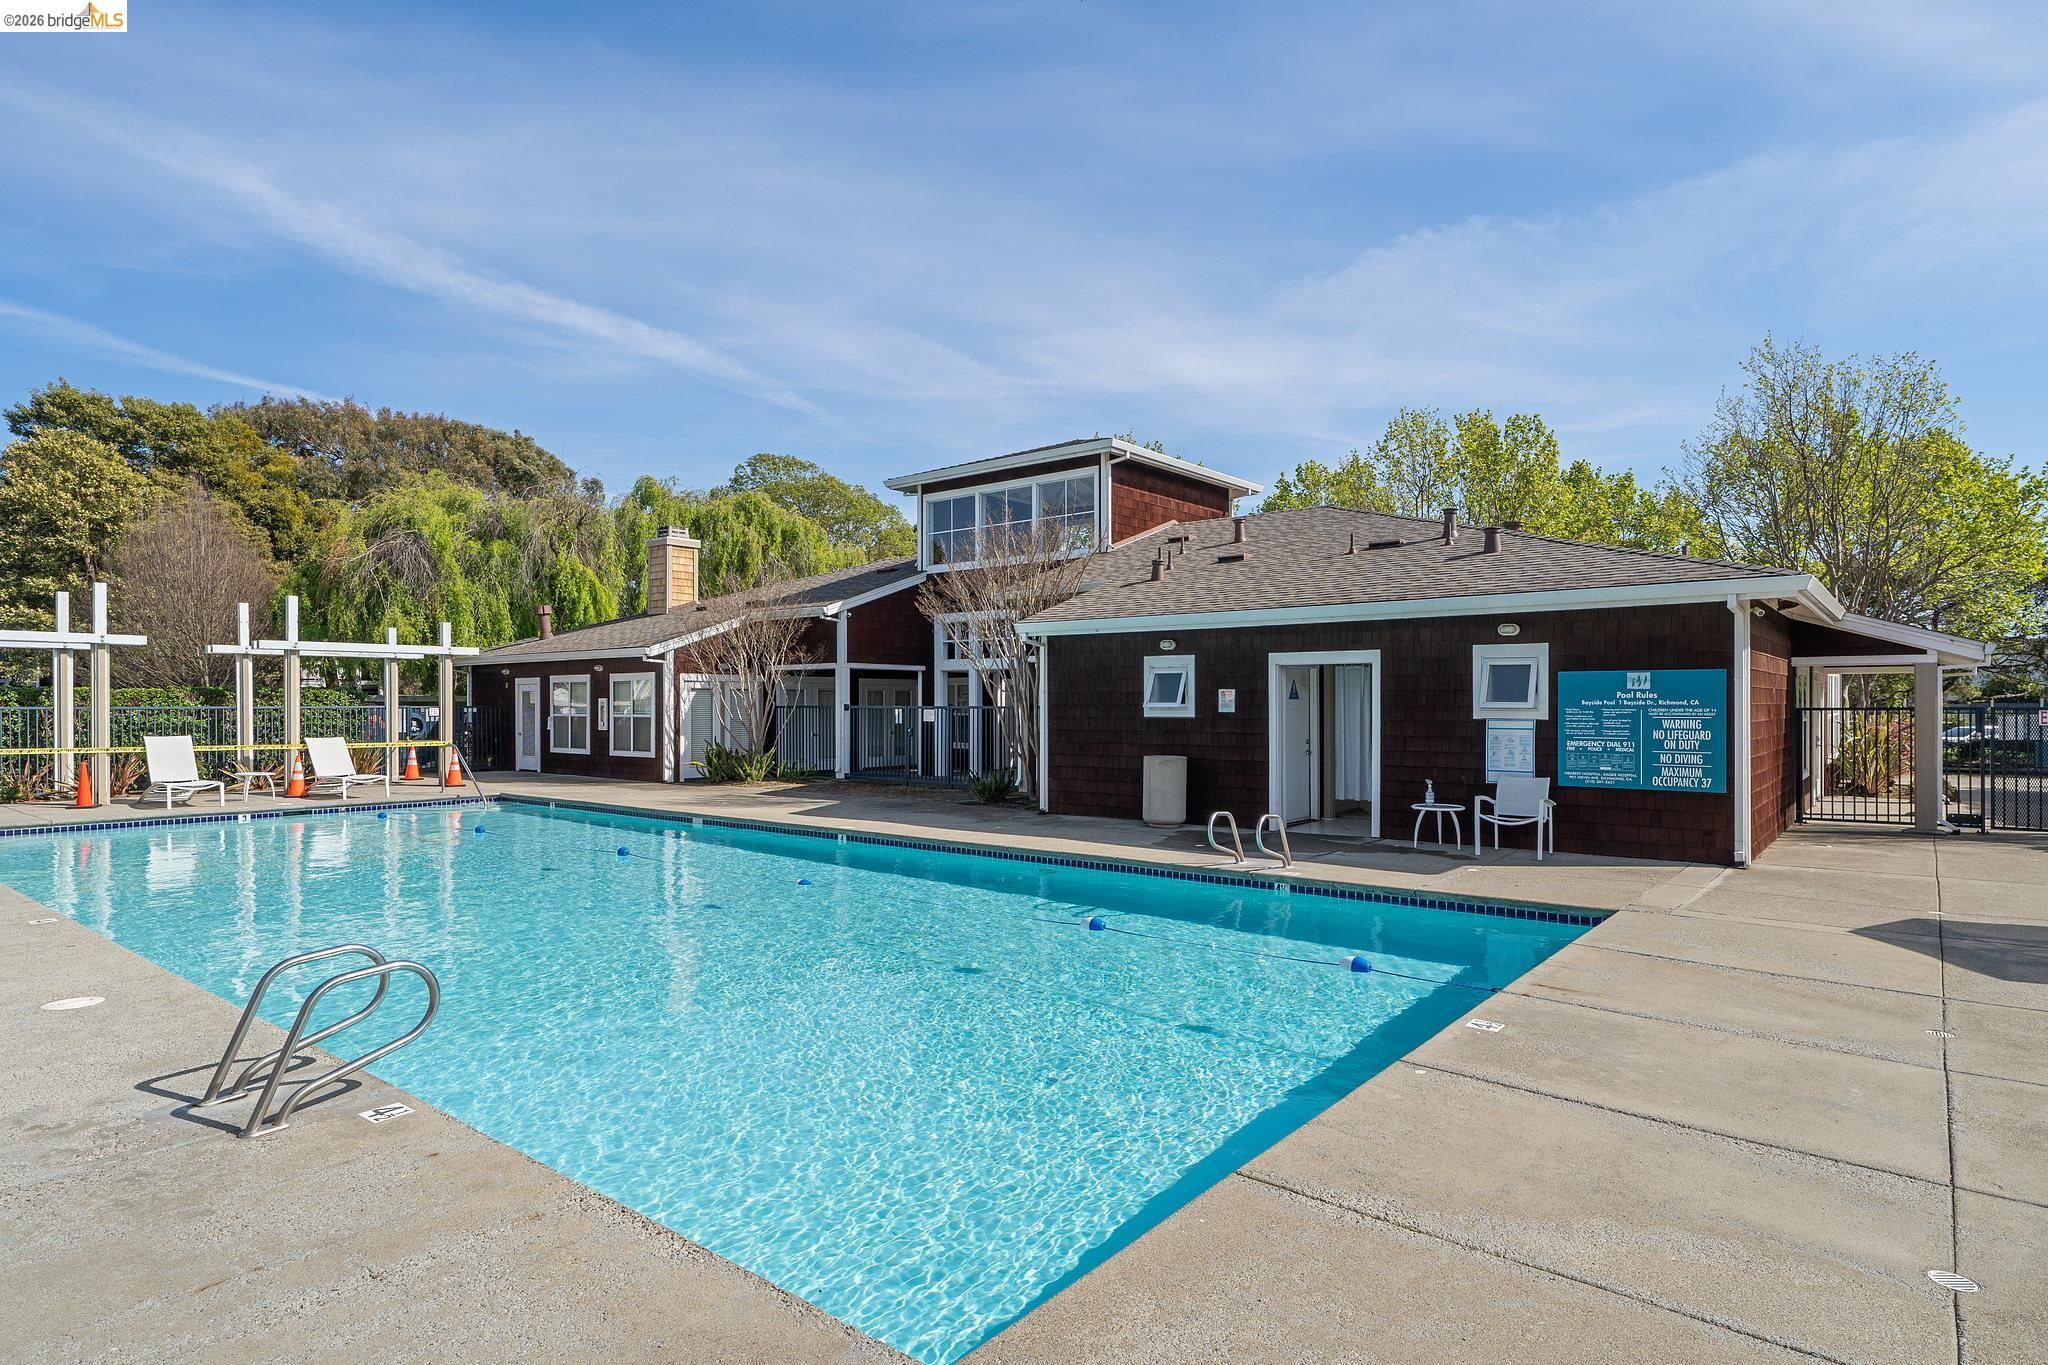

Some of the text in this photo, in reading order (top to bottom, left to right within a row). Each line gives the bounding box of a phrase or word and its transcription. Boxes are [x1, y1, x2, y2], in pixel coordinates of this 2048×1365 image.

[1616, 691, 1658, 699] Pool Rules
[1662, 719, 1702, 729] WARNING
[1652, 730, 1712, 740] NO LIFEGUARD
[1664, 740, 1700, 750] ON DUTY
[1660, 753, 1703, 765] NO DIVING
[1661, 767, 1703, 778] MAXIMUM
[1652, 776, 1712, 788] OCCUPANCY 37
